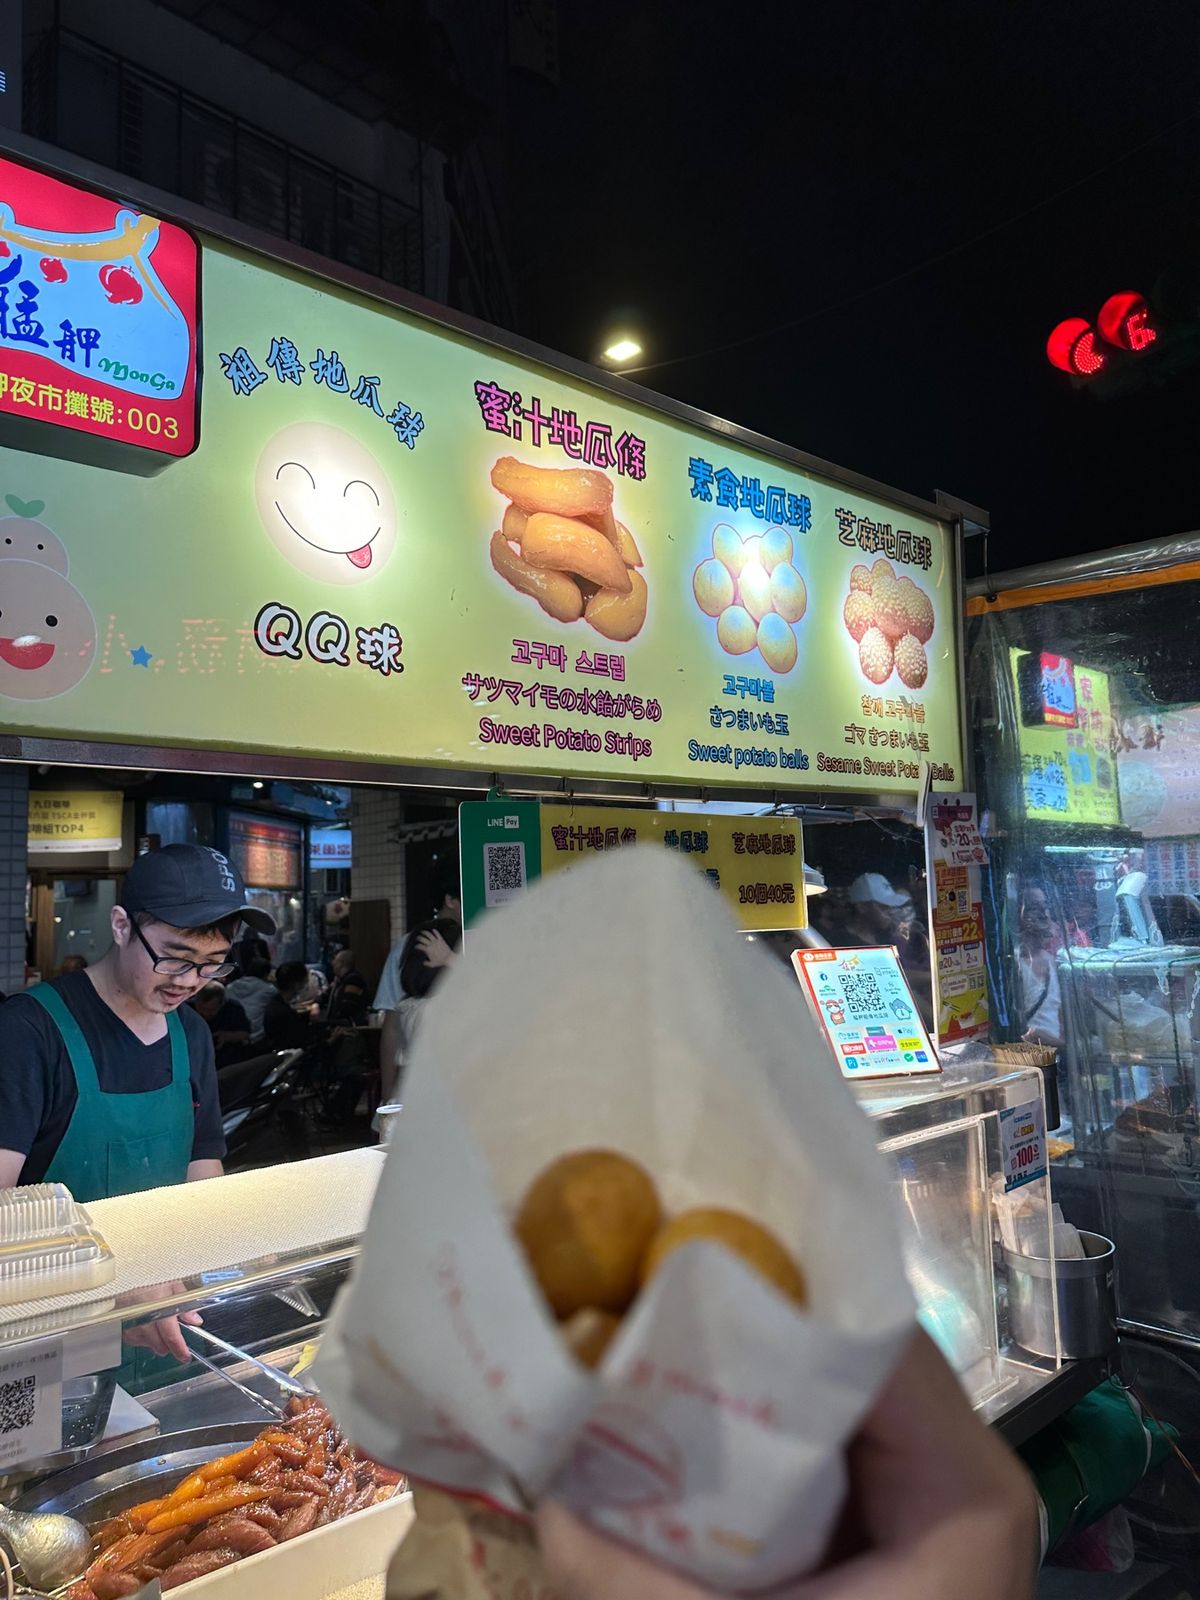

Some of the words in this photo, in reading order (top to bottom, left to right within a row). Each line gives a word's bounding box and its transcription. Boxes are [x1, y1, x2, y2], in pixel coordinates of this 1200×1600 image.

[219, 336, 425, 450] 祖傳地瓜球
[473, 380, 648, 481] 蜜汁地瓜條
[687, 456, 813, 533] 素食地瓜球
[834, 507, 933, 571] 芝麻地瓜球
[254, 602, 405, 677] QQ球
[511, 639, 567, 673] 고구마
[575, 650, 626, 682] 스트립
[461, 672, 663, 722] サツマイモの水飴がらめ
[722, 674, 775, 703] 고구마볼
[479, 717, 541, 748] Sweet
[543, 723, 602, 752] Potato
[604, 730, 653, 761] Strips
[708, 705, 790, 736] さつまいも玉
[687, 739, 733, 763] Sweet
[734, 745, 778, 769] potato
[779, 747, 810, 771] balls
[816, 752, 862, 775] Sesame
[863, 756, 897, 778] Sweet
[897, 759, 920, 779] Pota
[931, 762, 955, 782] Balls
[487, 818, 504, 827] LINE
[505, 817, 519, 828] Pay
[732, 831, 796, 855] 芝麻地瓜球
[738, 881, 796, 905] 10個40元
